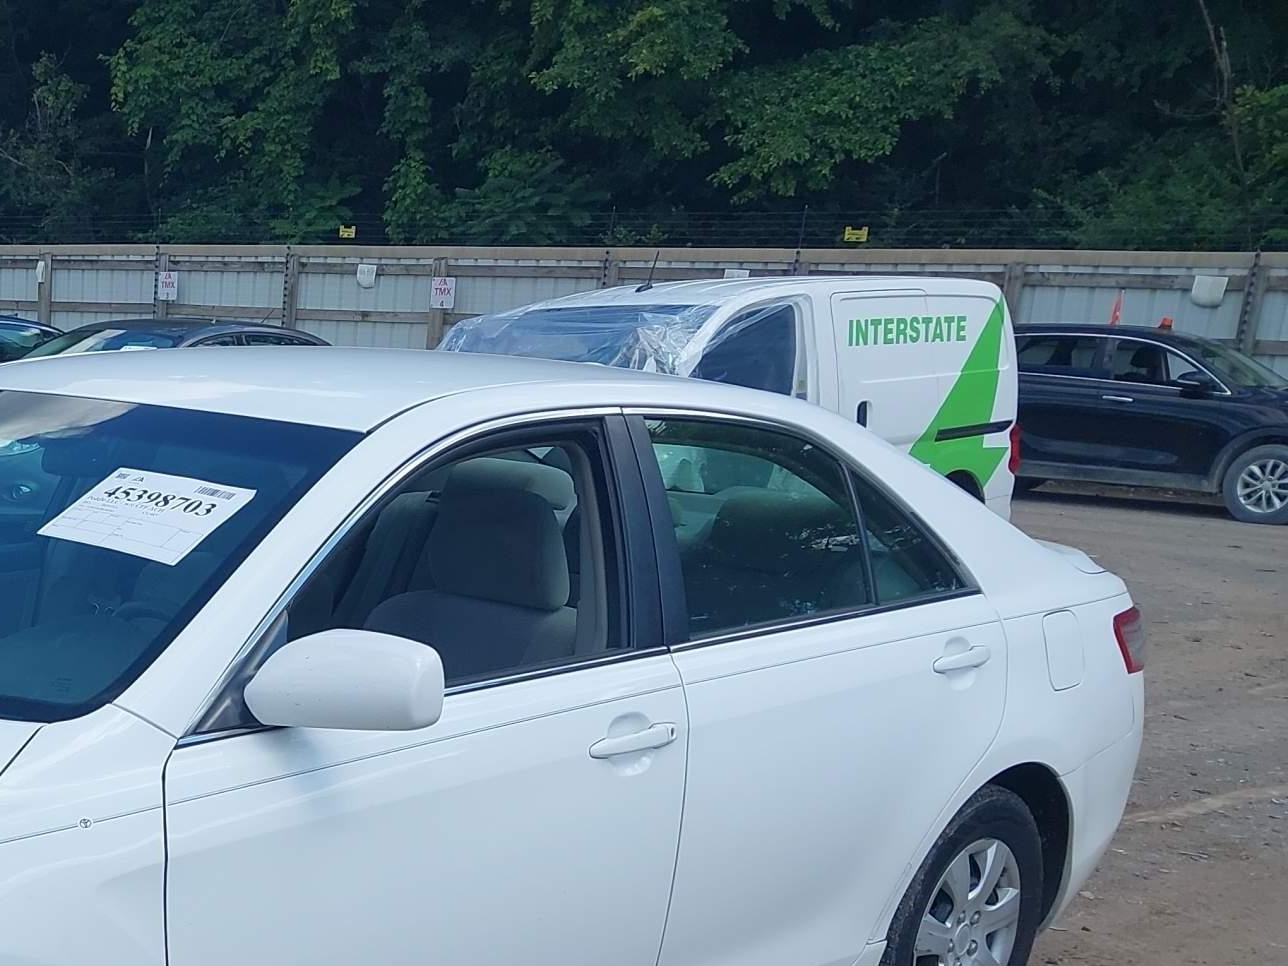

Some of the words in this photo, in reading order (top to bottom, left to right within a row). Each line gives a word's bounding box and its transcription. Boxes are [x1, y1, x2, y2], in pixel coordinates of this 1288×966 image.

[435, 287, 451, 296] TMX
[847, 315, 968, 347] INTERSTATE
[104, 486, 217, 517] 45398703
